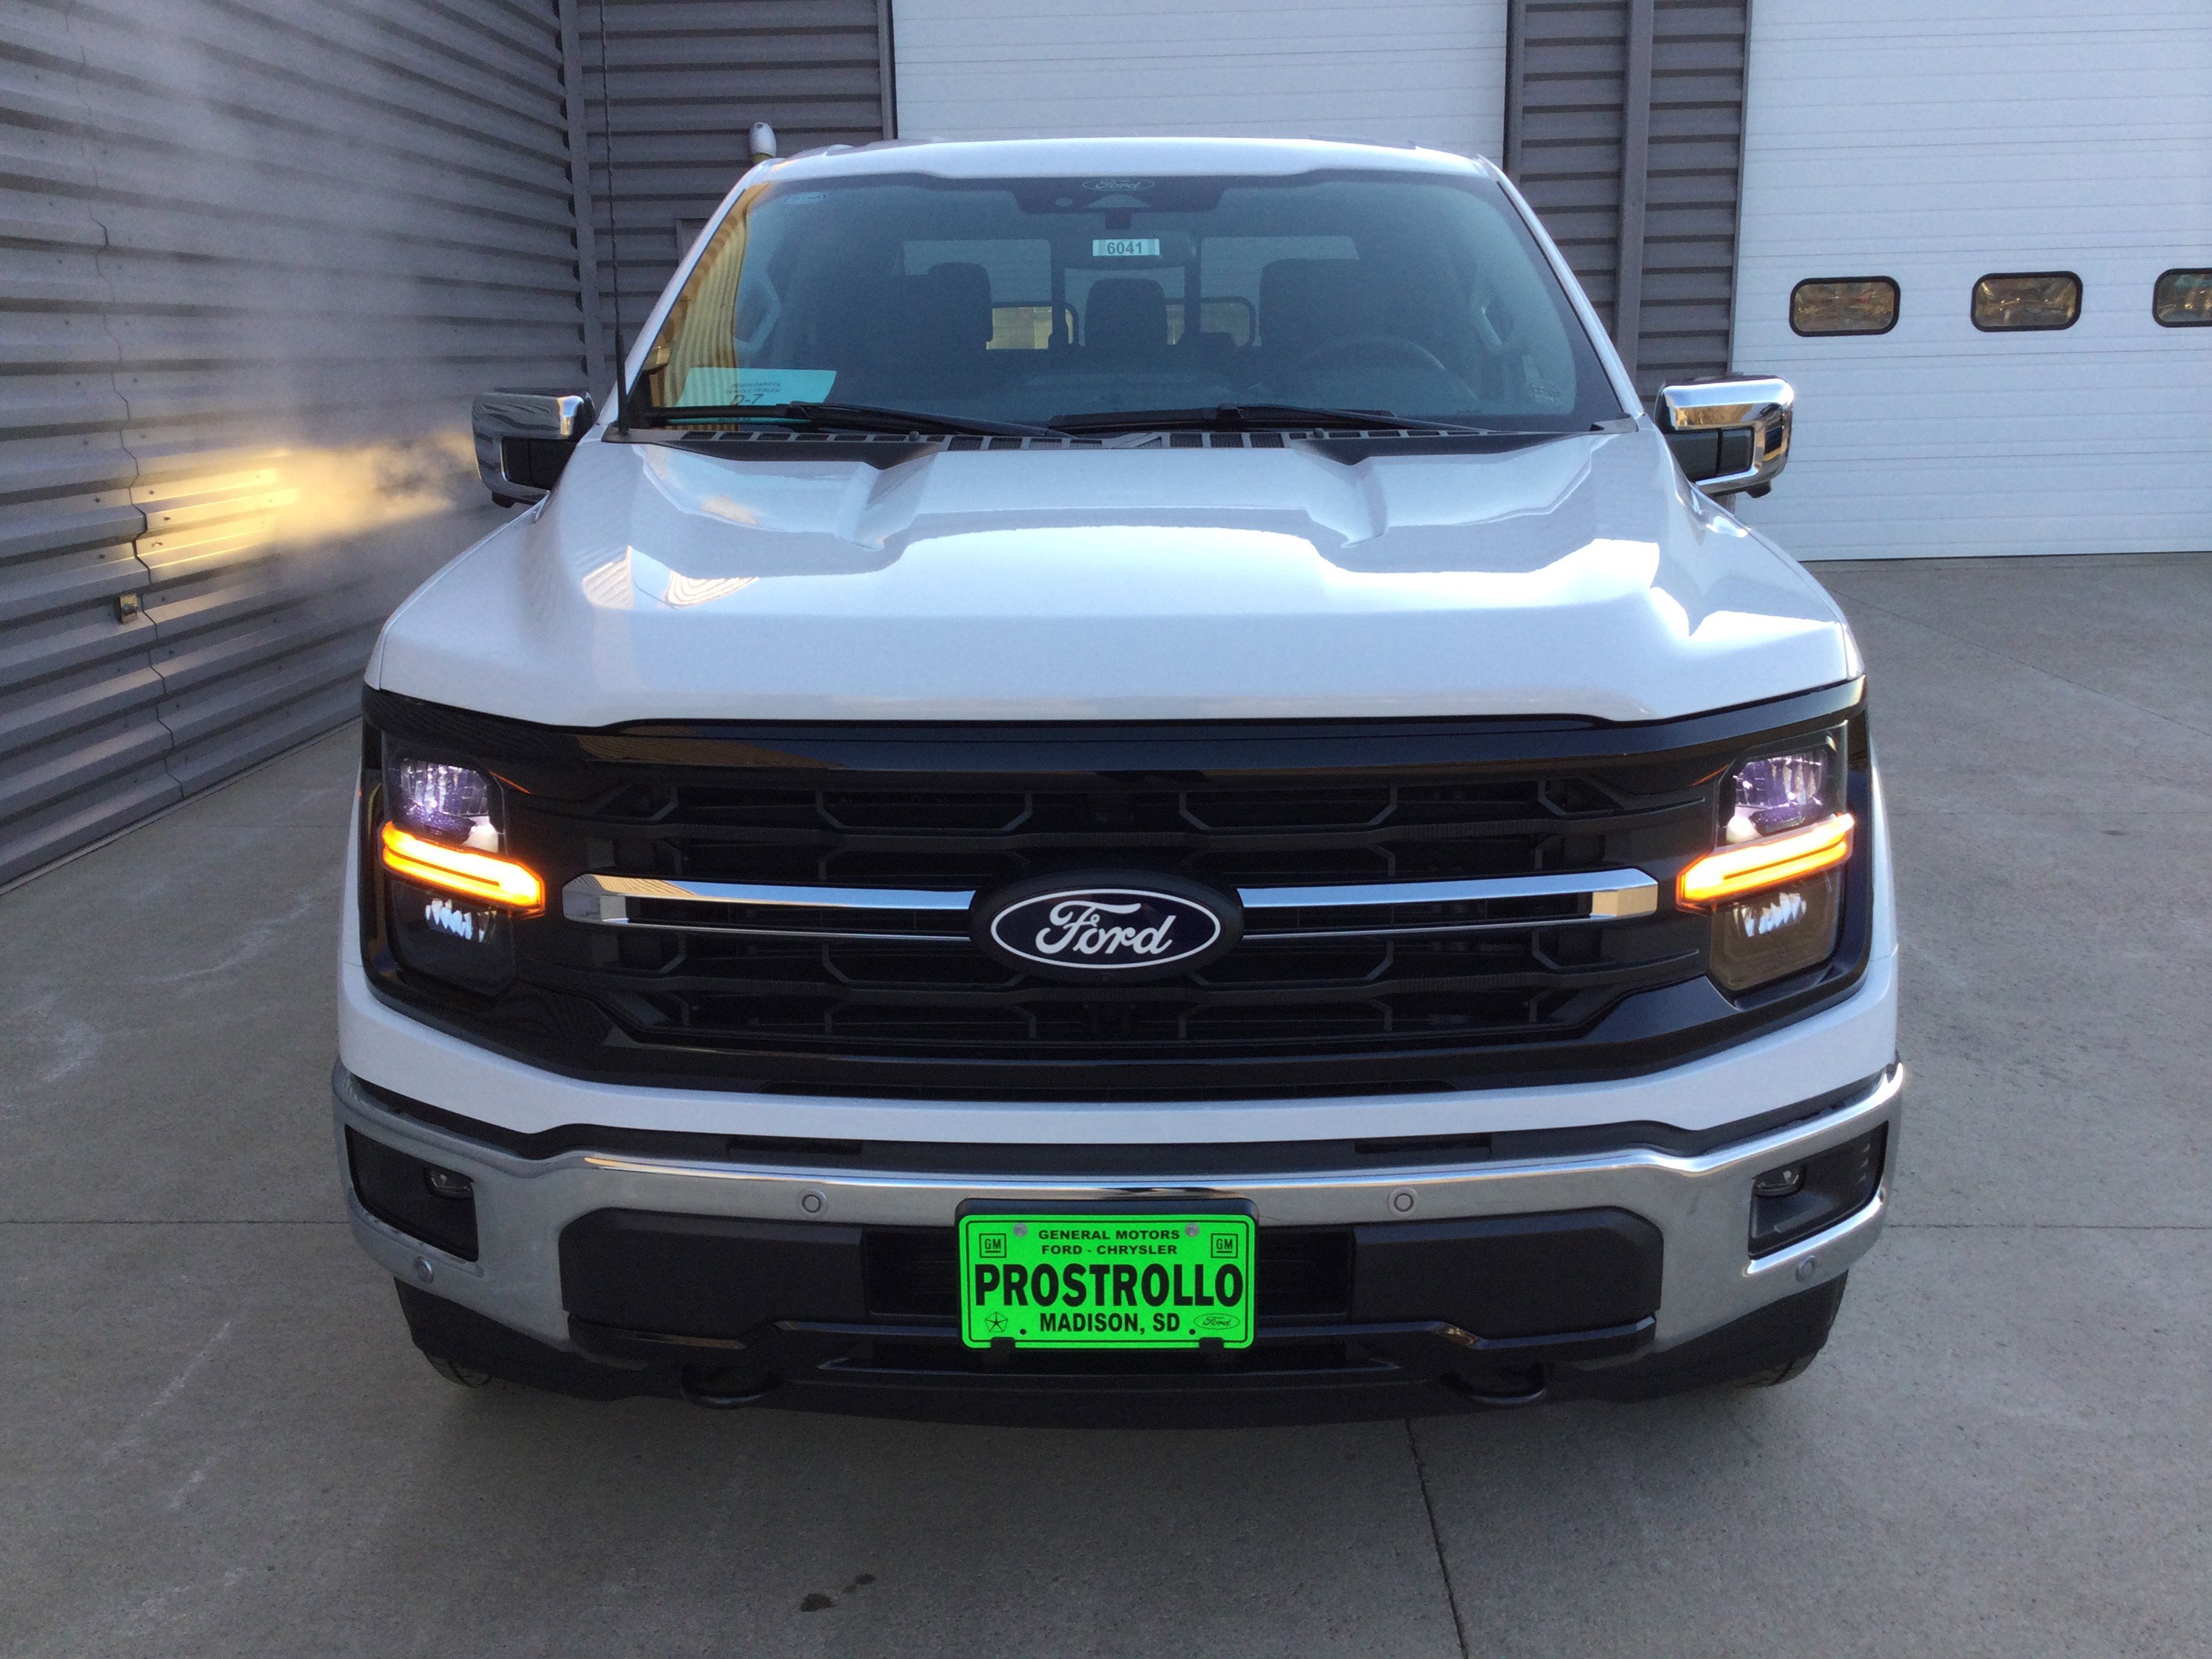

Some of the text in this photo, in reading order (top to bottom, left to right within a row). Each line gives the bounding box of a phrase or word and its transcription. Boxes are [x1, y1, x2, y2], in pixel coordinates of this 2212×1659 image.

[1095, 178, 1142, 190] Ford
[1107, 241, 1143, 255] 6041
[1036, 900, 1176, 955] Ford
[1038, 1229, 1181, 1240] GENERAL MOTORS
[984, 1238, 1002, 1250] GM
[1042, 1244, 1082, 1254] FORD
[1097, 1244, 1178, 1255] CHRYSLER
[1216, 1238, 1233, 1250] GM
[975, 1263, 1244, 1307] PROSTROLLO
[1040, 1313, 1181, 1335] MADISON, SD
[1202, 1316, 1231, 1328] Ford
